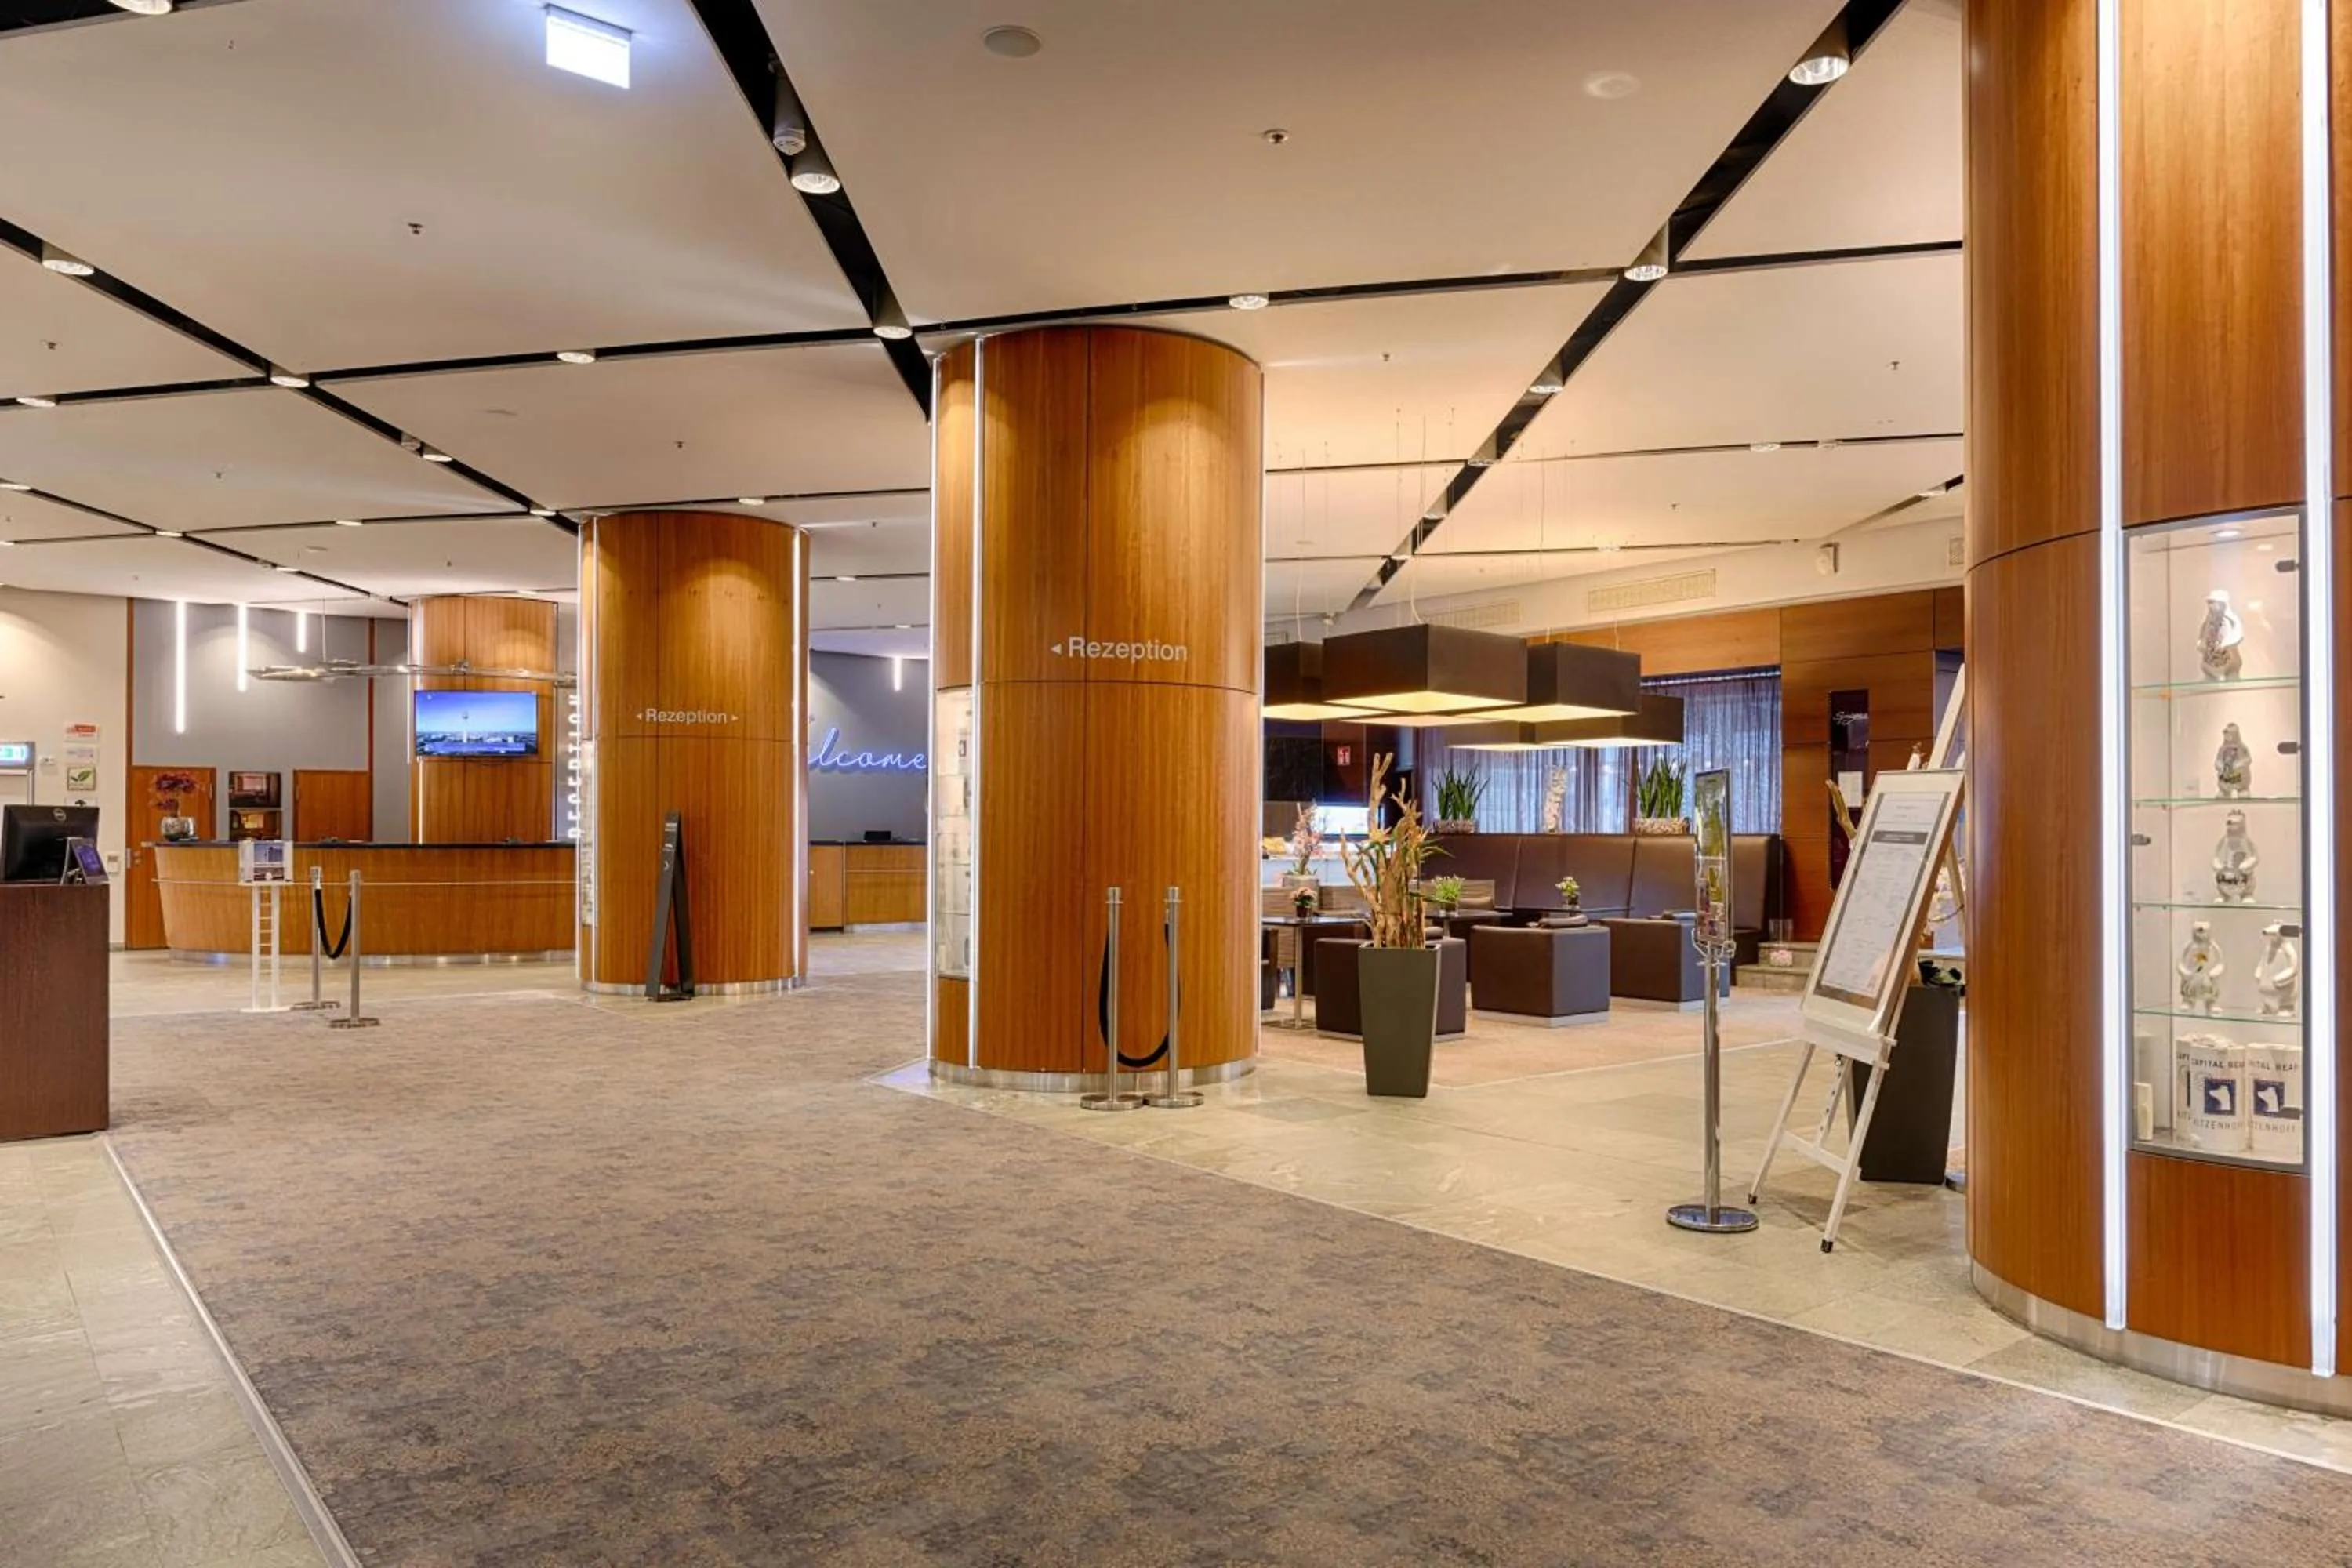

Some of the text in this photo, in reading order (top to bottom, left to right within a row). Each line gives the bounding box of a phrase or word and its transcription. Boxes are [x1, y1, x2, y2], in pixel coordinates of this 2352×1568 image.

[1068, 636, 1188, 664] Rezeption
[645, 708, 728, 725] Rezeption
[808, 727, 927, 770] lcome
